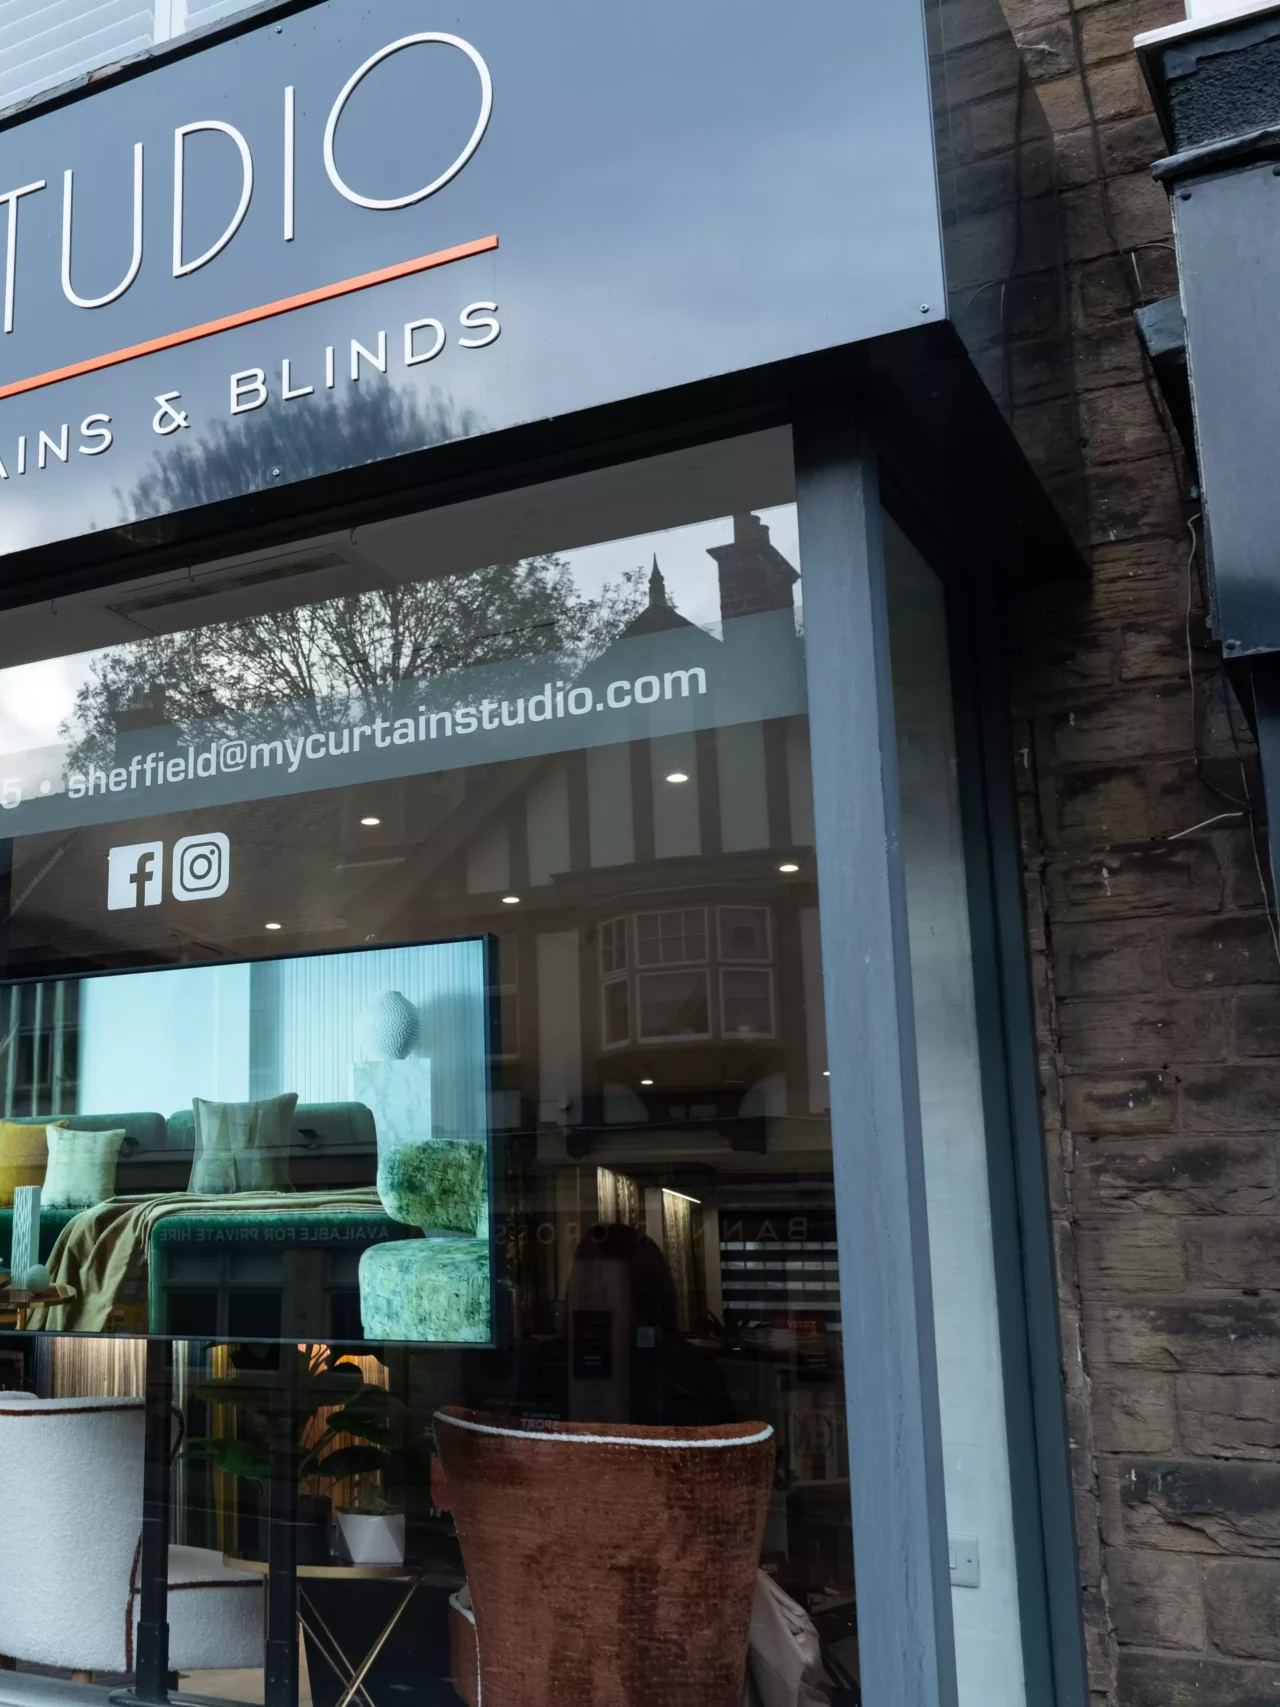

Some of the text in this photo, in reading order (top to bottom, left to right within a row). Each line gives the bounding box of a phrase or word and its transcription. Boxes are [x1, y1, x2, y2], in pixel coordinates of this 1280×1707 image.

[152, 391, 191, 435] &
[229, 301, 502, 415] BLINDS
[67, 666, 708, 799] sheffield@mycurtainstudio.com
